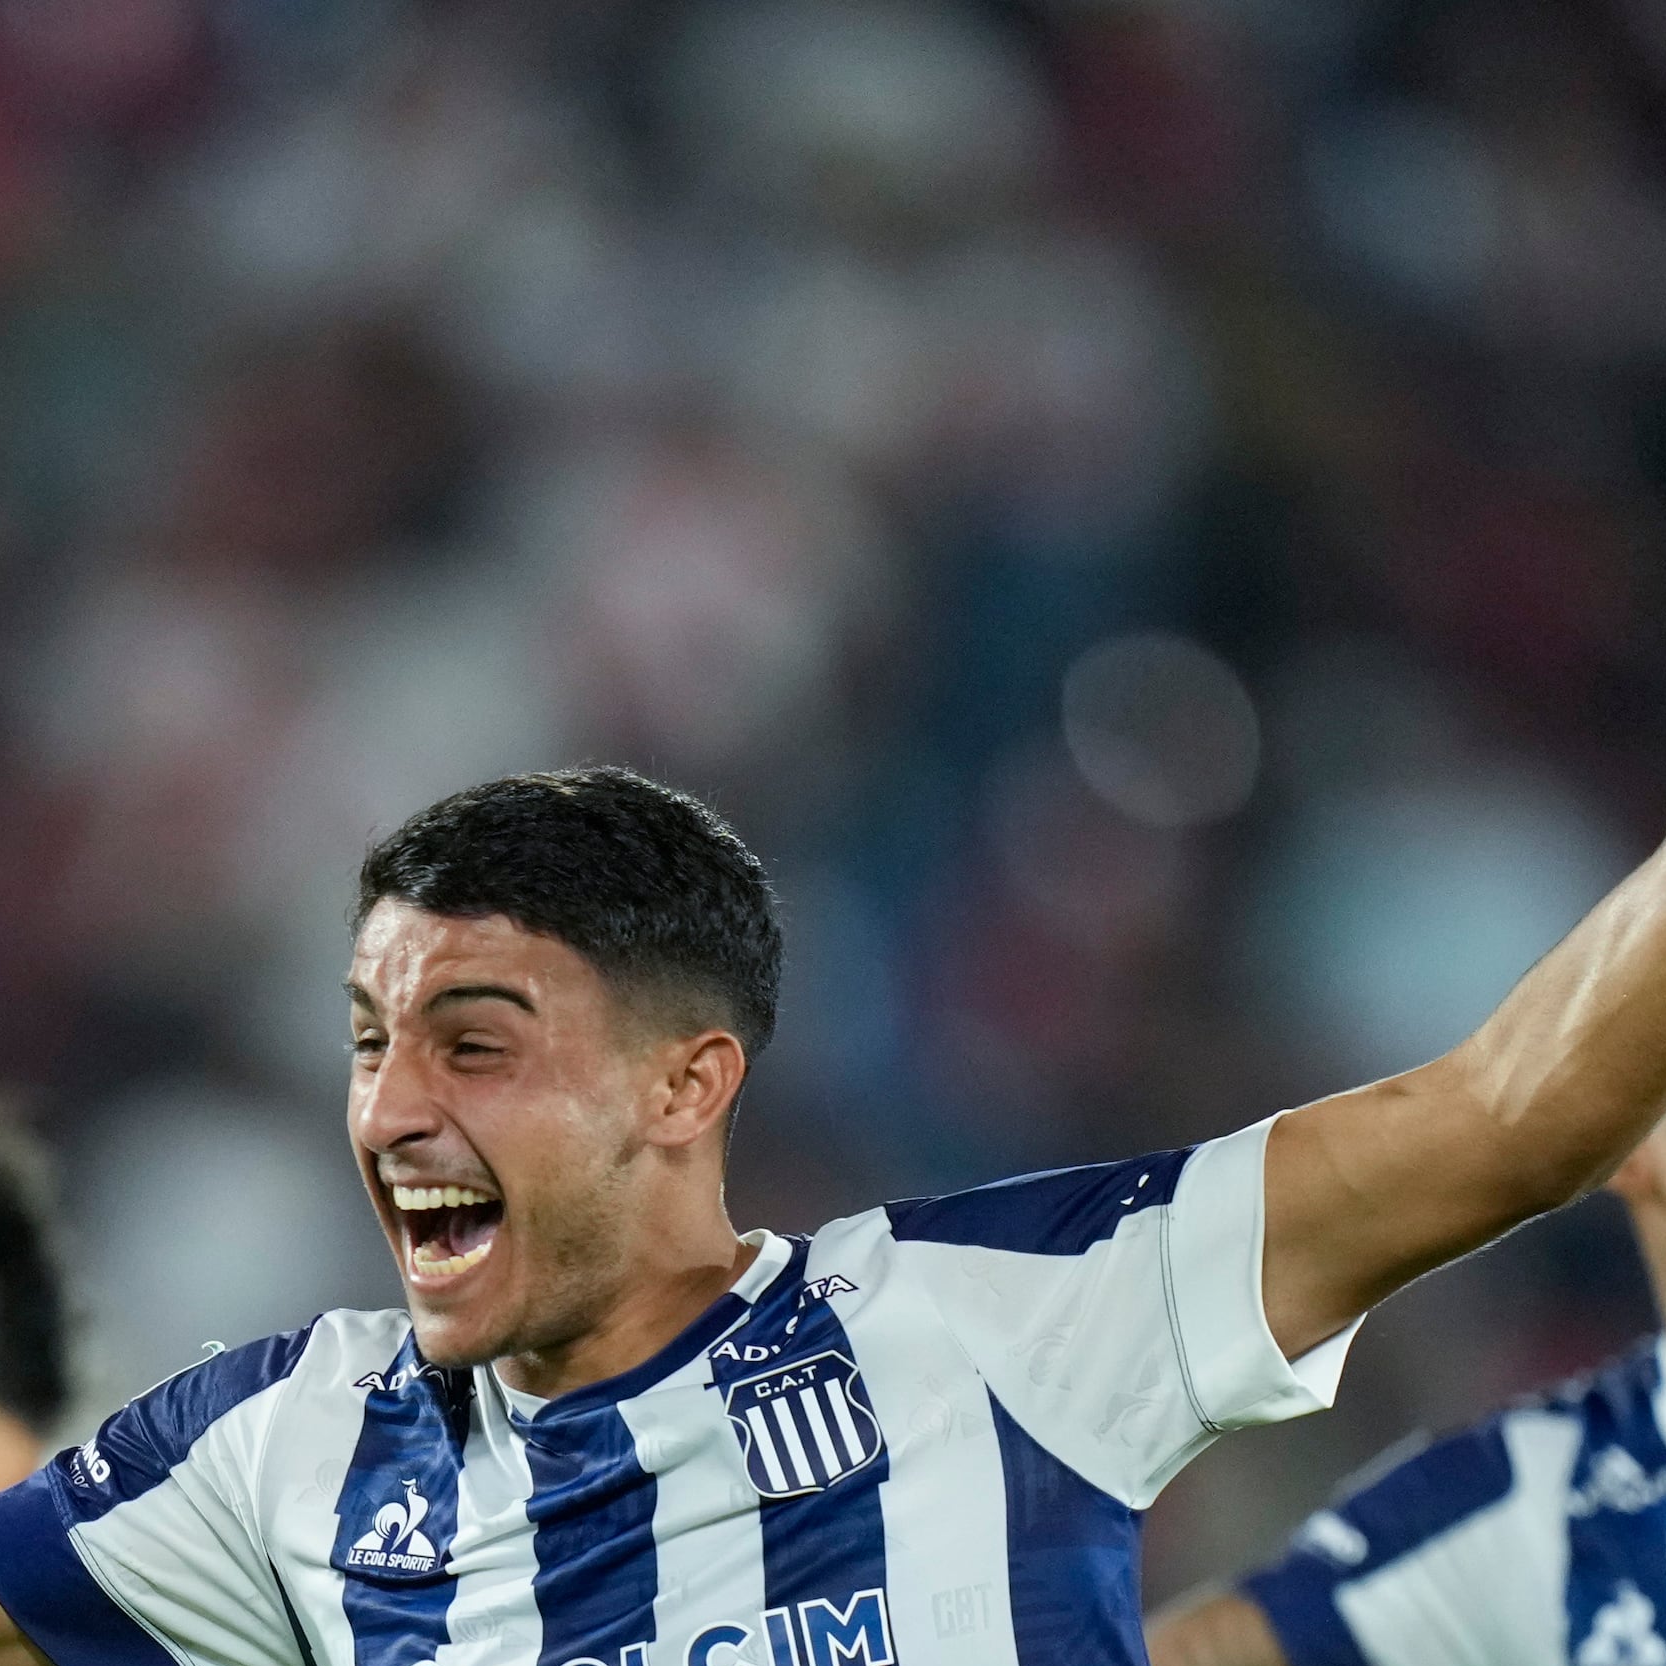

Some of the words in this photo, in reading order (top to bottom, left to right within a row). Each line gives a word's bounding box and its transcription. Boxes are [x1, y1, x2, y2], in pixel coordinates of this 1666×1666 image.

[347, 1549, 363, 1566] LE
[363, 1551, 387, 1568] COQ
[387, 1555, 436, 1572] SPORTIF
